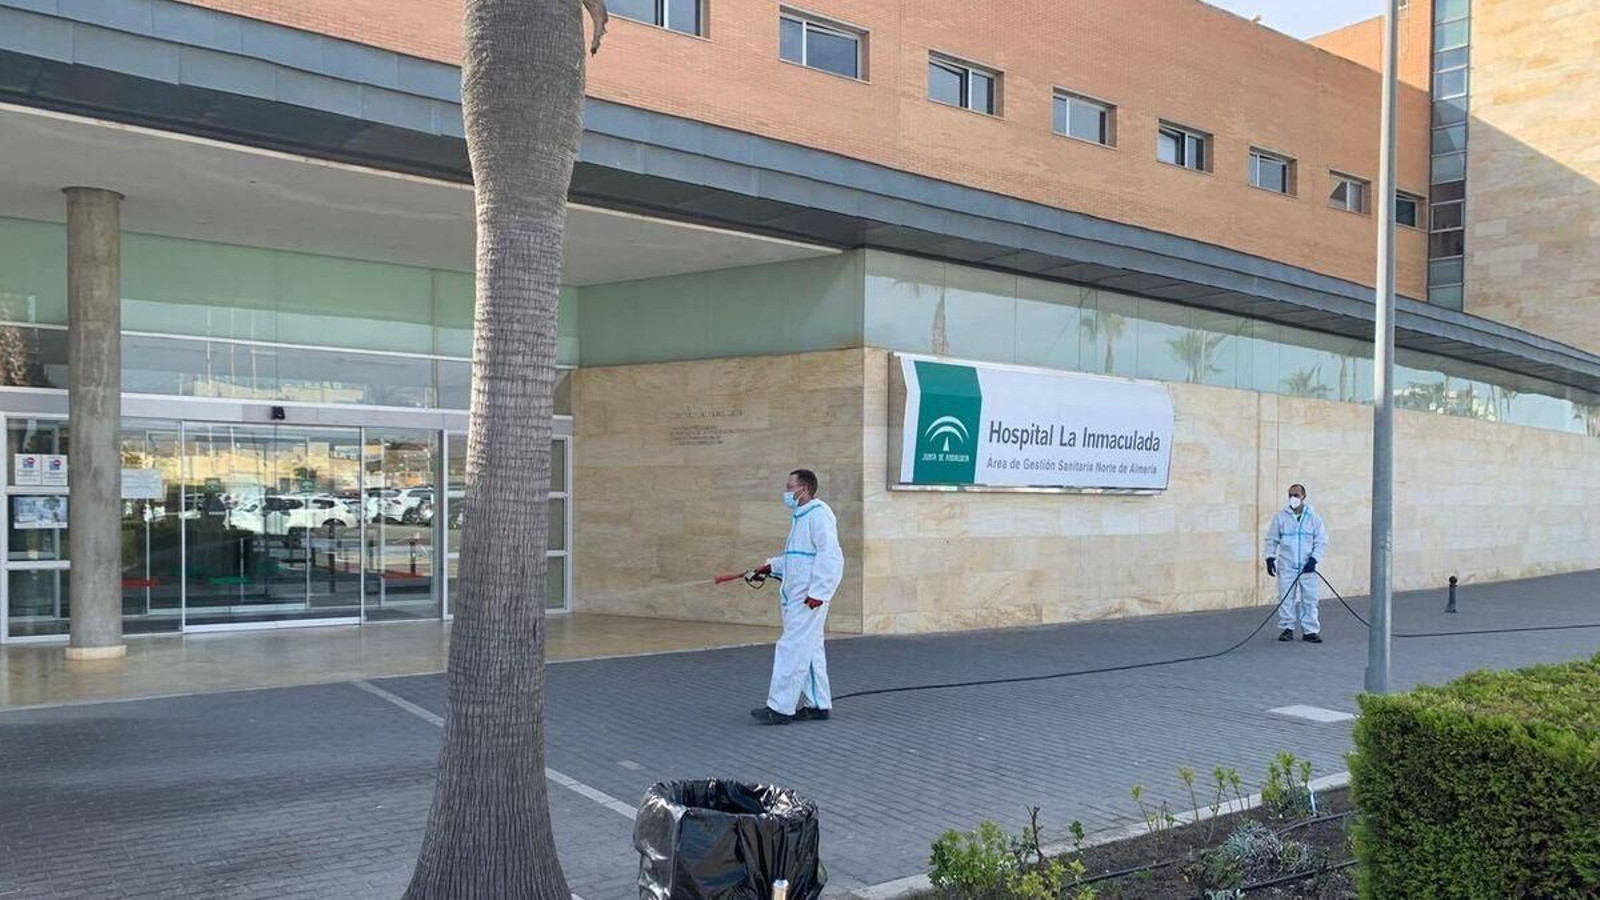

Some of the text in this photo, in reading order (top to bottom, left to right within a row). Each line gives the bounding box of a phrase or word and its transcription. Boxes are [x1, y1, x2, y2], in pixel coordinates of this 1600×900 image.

[989, 420, 1161, 451] Hospital La Inmaculada
[1010, 458, 1021, 469] de
[1023, 458, 1055, 471] Gestión
[1058, 459, 1093, 473] Sanitaria
[1095, 461, 1117, 474] Norte
[1118, 463, 1128, 474] de
